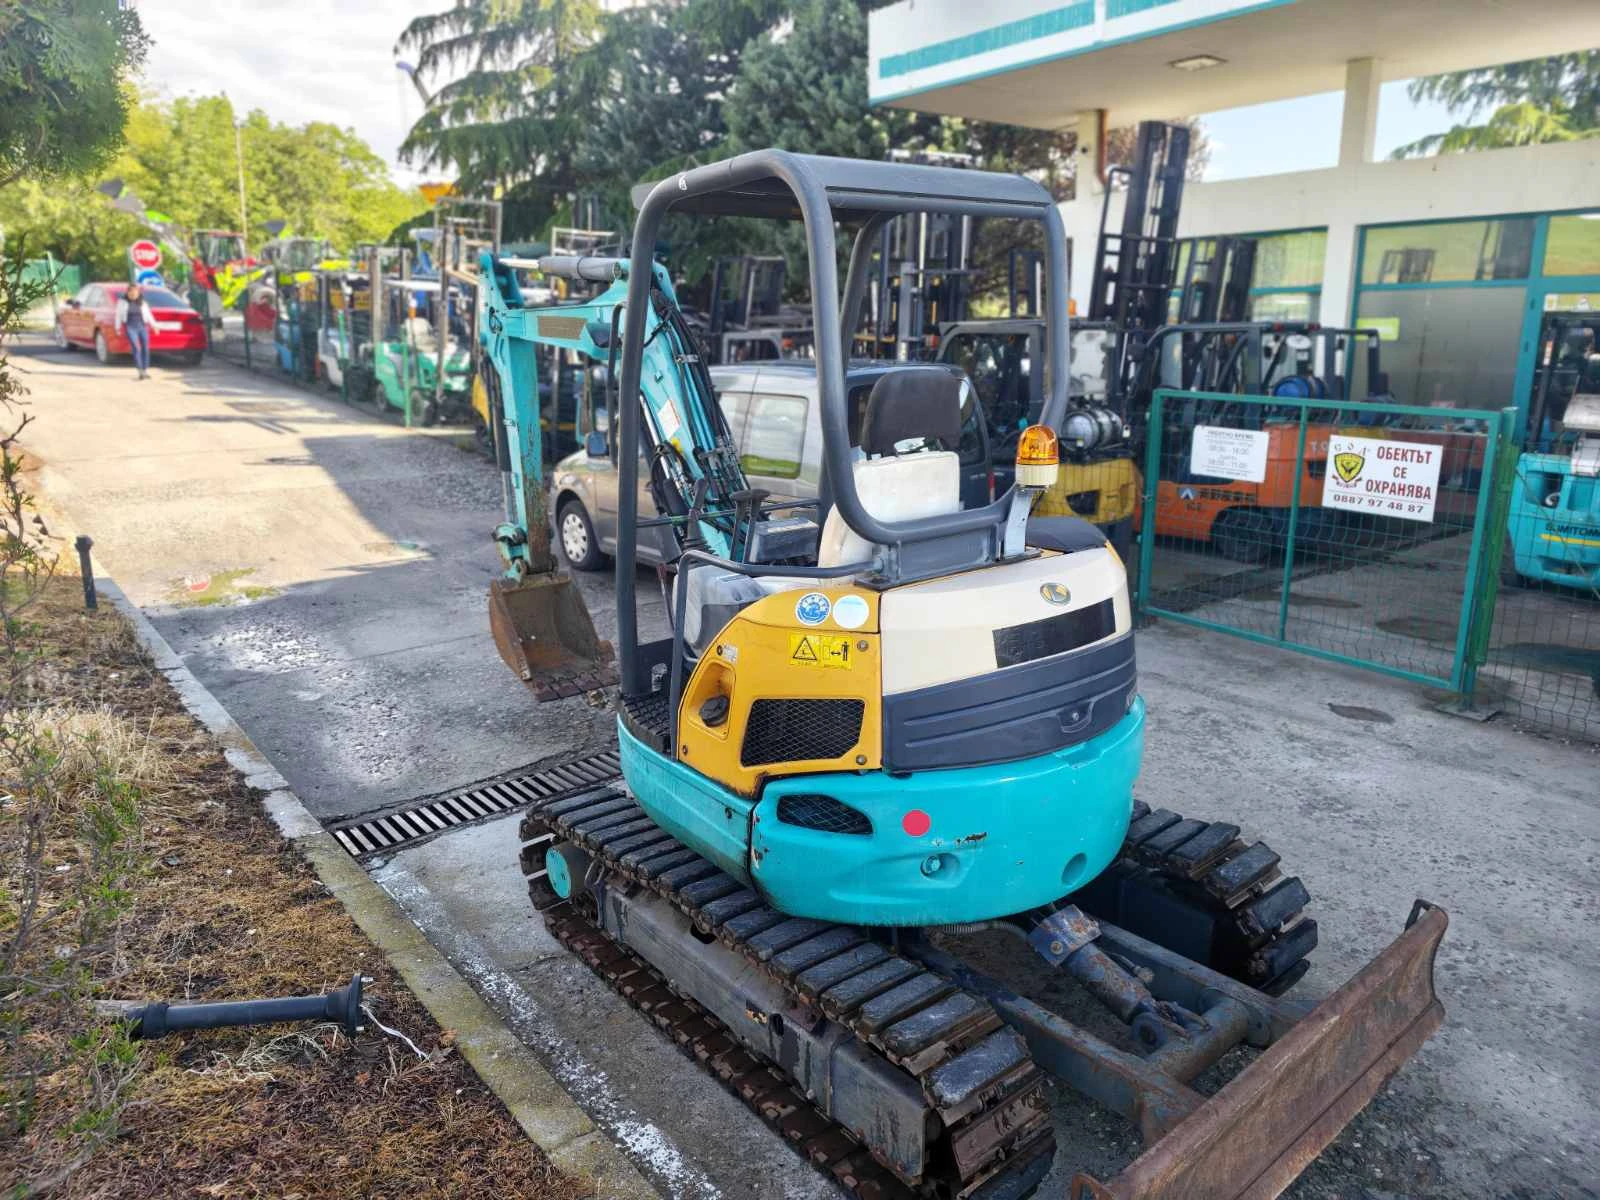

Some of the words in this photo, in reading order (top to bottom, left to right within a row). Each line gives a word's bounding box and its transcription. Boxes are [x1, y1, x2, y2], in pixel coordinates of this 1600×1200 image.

[1376, 446, 1433, 464] ОБЕКТЪТ
[1393, 466, 1409, 479] СЕ
[1366, 479, 1432, 500] ОХРАНЯВА
[1333, 494, 1364, 505] 0887
[1368, 498, 1383, 507] 97
[1387, 501, 1403, 511] 48
[1407, 504, 1424, 513] 87
